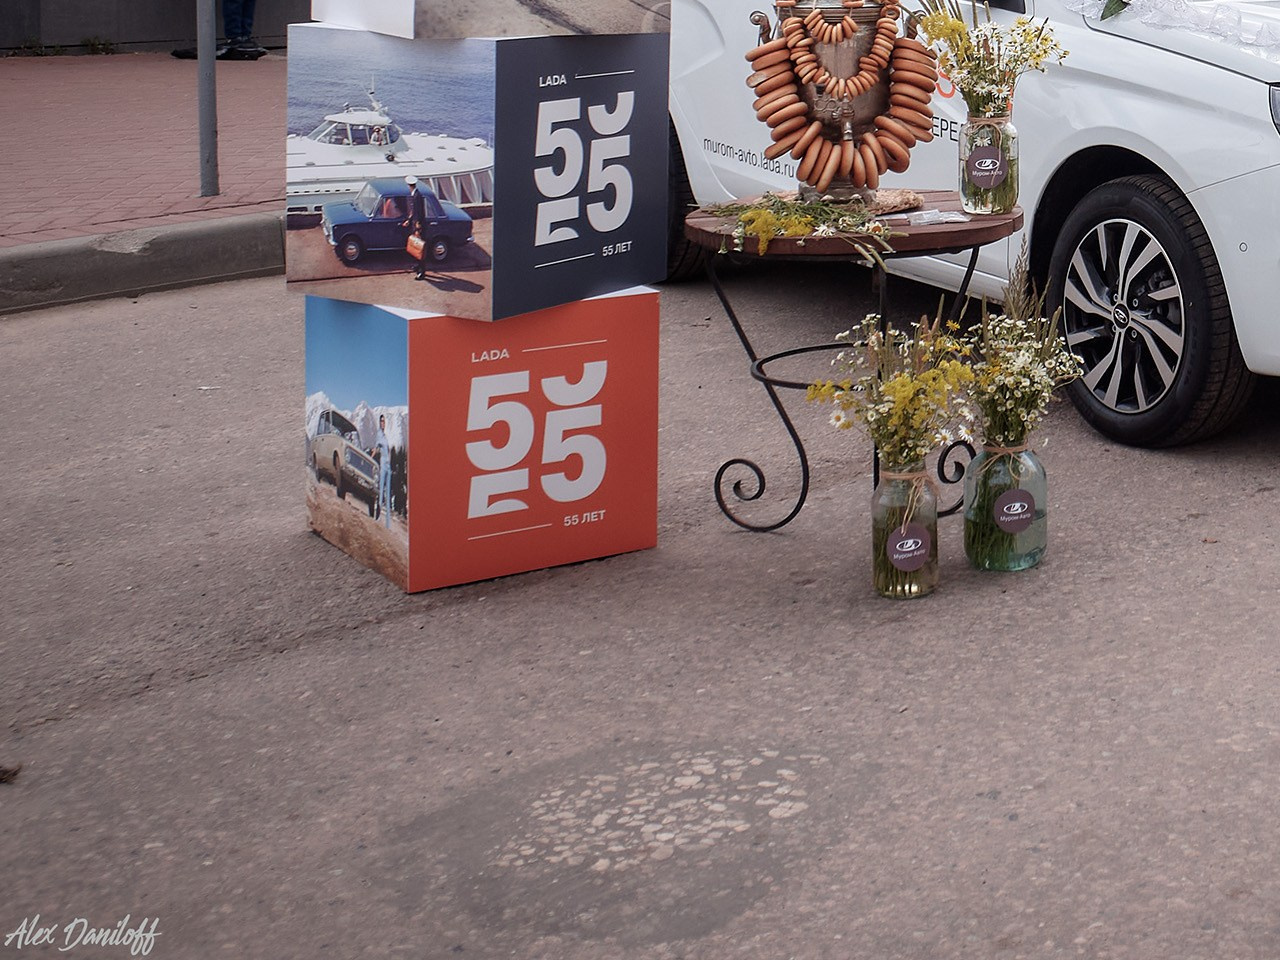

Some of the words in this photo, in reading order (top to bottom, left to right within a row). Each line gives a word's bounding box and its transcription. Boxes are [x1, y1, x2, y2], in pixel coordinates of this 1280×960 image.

[539, 75, 567, 87] LADA
[931, 116, 964, 142] ЕРЕ
[602, 244, 614, 257] 55
[614, 241, 633, 255] ЛЕТ
[471, 348, 510, 363] LADA
[563, 514, 580, 527] 55
[581, 509, 606, 525] ЛЕТ
